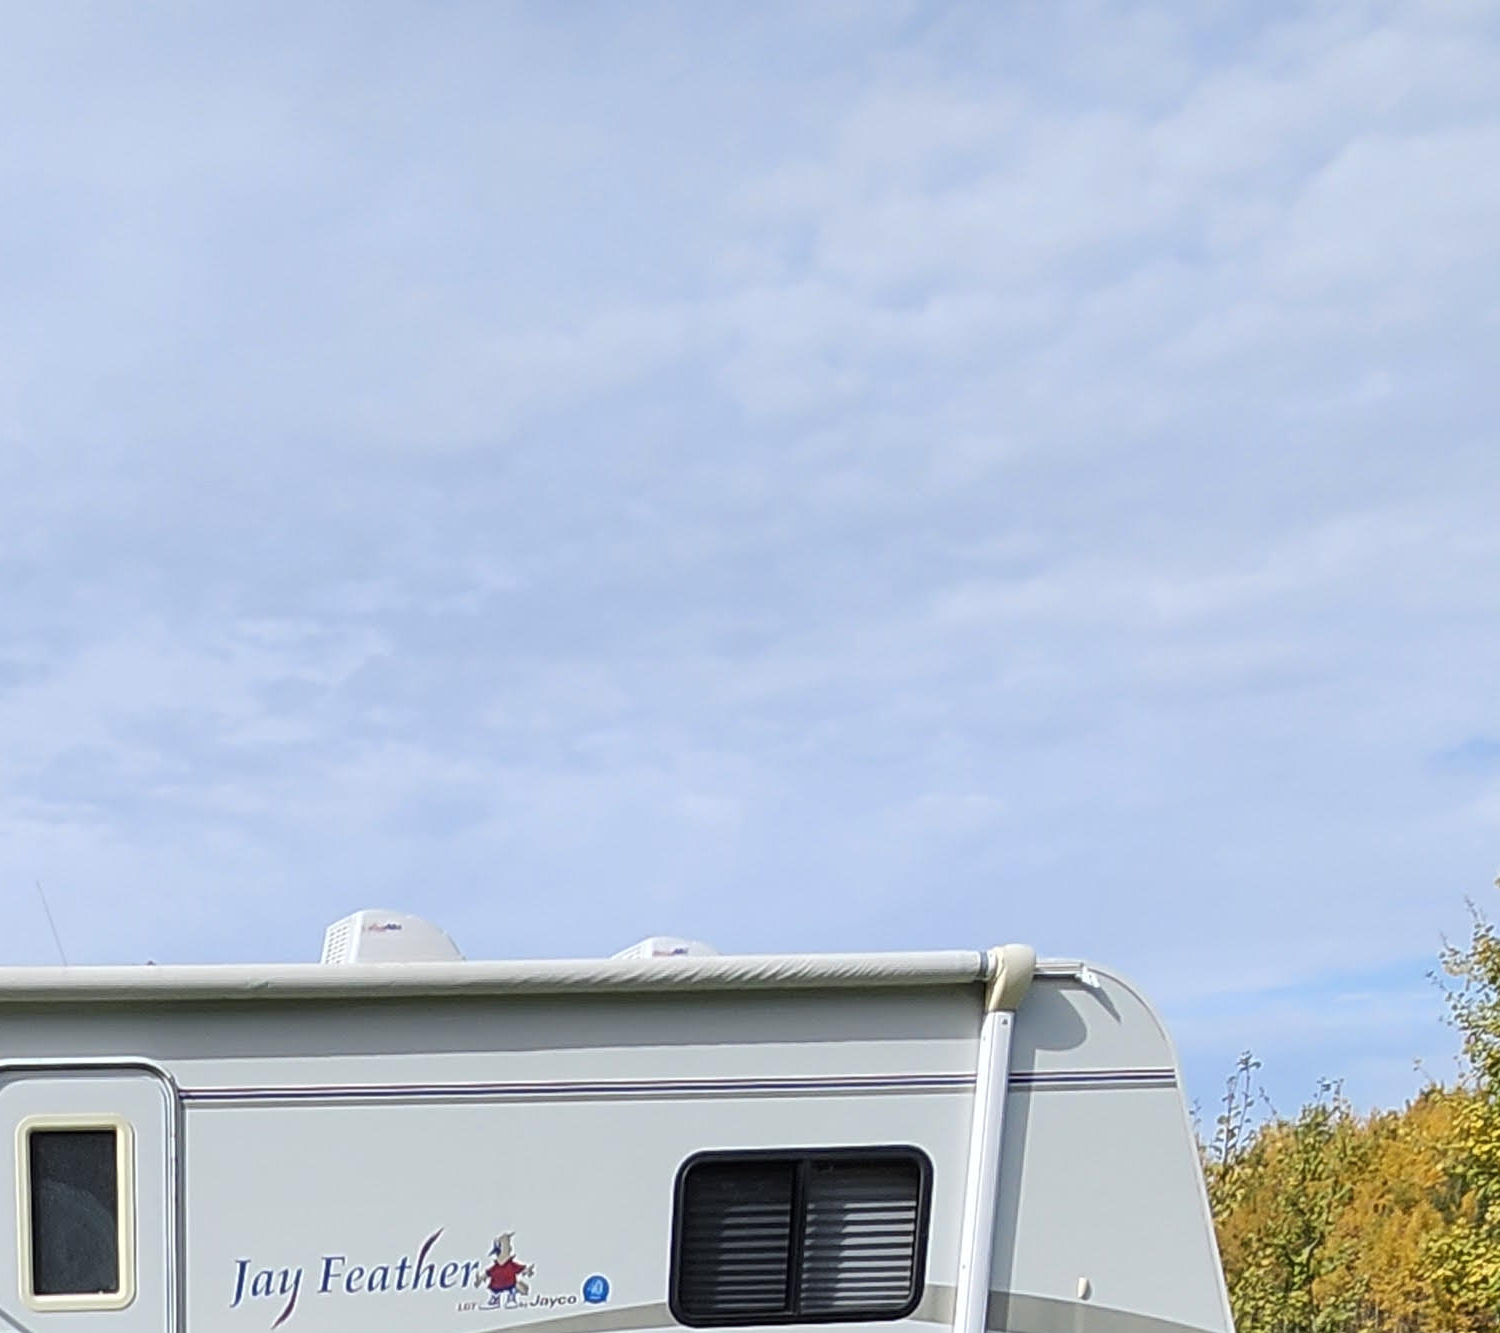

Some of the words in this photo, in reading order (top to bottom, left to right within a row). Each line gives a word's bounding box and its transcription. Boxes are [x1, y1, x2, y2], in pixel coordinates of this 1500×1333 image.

[229, 1258, 302, 1330] Jay
[318, 1227, 479, 1294] Feather
[529, 1294, 577, 1309] Jayco
